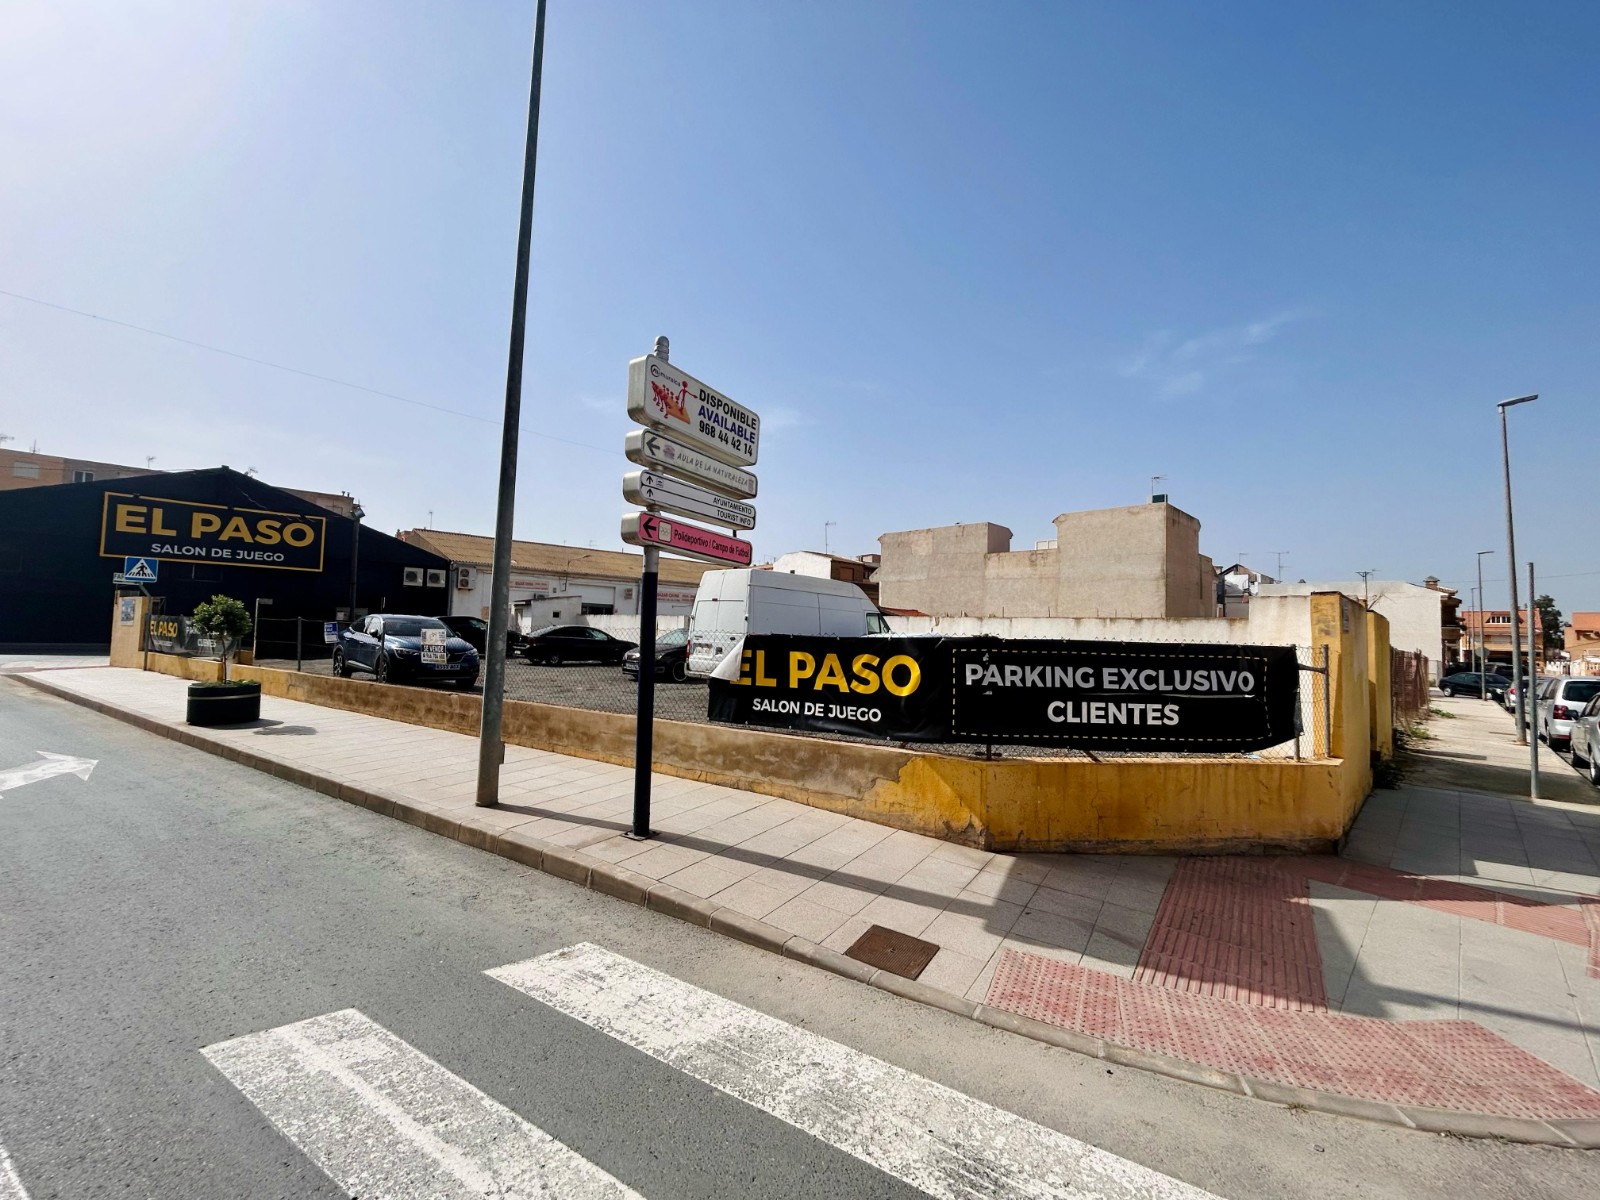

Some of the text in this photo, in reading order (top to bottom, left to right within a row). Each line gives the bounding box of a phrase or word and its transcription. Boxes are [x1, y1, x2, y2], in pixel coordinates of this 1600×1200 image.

[699, 389, 757, 430] DISPONIBLE
[698, 405, 756, 445] AVAILABLE
[699, 420, 753, 457] 968 44 42 14
[677, 453, 748, 487] AULA DE LA NATURALEZA
[713, 497, 752, 514] AYUNTAMIENTO
[717, 510, 739, 522] TOURIST
[115, 503, 315, 547] EL PASO
[150, 543, 285, 562] SALON DE JUEGO
[674, 529, 709, 548] Polideportivo
[712, 540, 729, 554] Campo
[729, 545, 735, 554] de
[157, 621, 178, 638] PASO
[789, 651, 922, 697] PASO
[965, 663, 1255, 692] PARKING EXCLUSIVO
[752, 698, 882, 723] SALON DE JUEGO
[1047, 701, 1180, 726] CLIENTES
